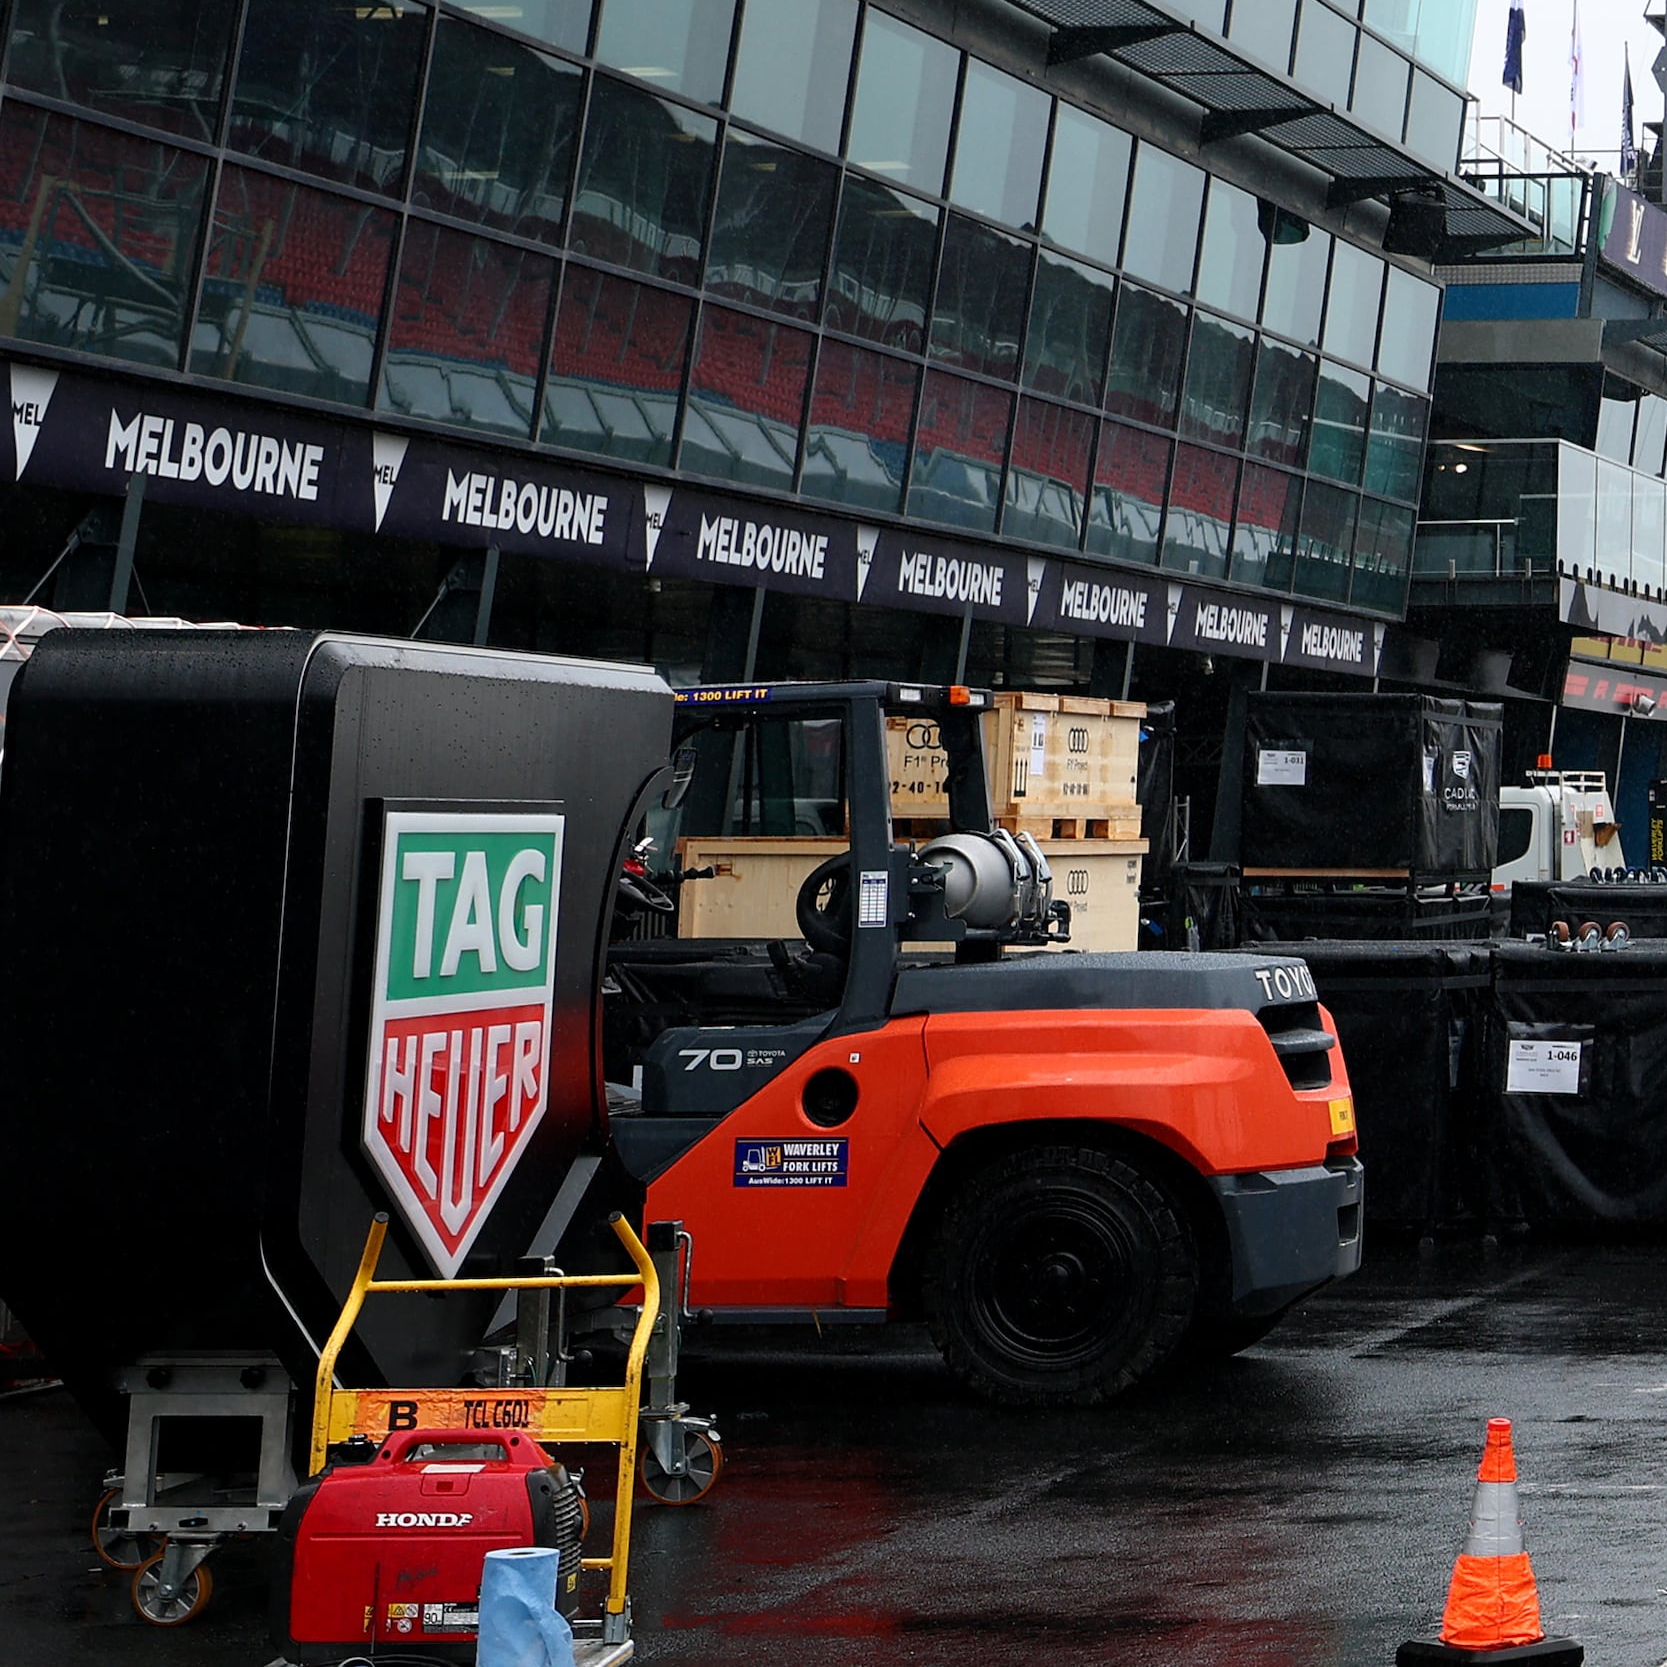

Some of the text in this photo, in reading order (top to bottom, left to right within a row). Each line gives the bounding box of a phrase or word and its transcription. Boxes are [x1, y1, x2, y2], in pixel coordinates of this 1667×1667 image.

[12, 401, 43, 425] MEL
[105, 407, 324, 501] MELBOURNE
[374, 464, 398, 486] MEL
[442, 469, 607, 545] MELBOURNE
[696, 513, 829, 579] MELBOURNE
[899, 550, 1004, 607] MELBOURNE
[1060, 579, 1148, 629] MELBOURNE
[1195, 604, 1268, 647] MELBOURNE
[1301, 622, 1363, 663] MELBOURNE
[693, 691, 722, 701] 1300
[725, 690, 752, 700] LIFT
[754, 689, 769, 699] IT
[403, 849, 546, 978] TAG
[678, 1049, 743, 1070] 70
[1547, 1050, 1577, 1061] 1-046
[382, 1021, 541, 1235] HEUER
[783, 1143, 839, 1156] WAVERLEY
[783, 1162, 838, 1172] FORK LIFTS
[388, 1401, 418, 1431] B
[464, 1400, 489, 1429] TCL
[424, 1613, 437, 1624] 90
